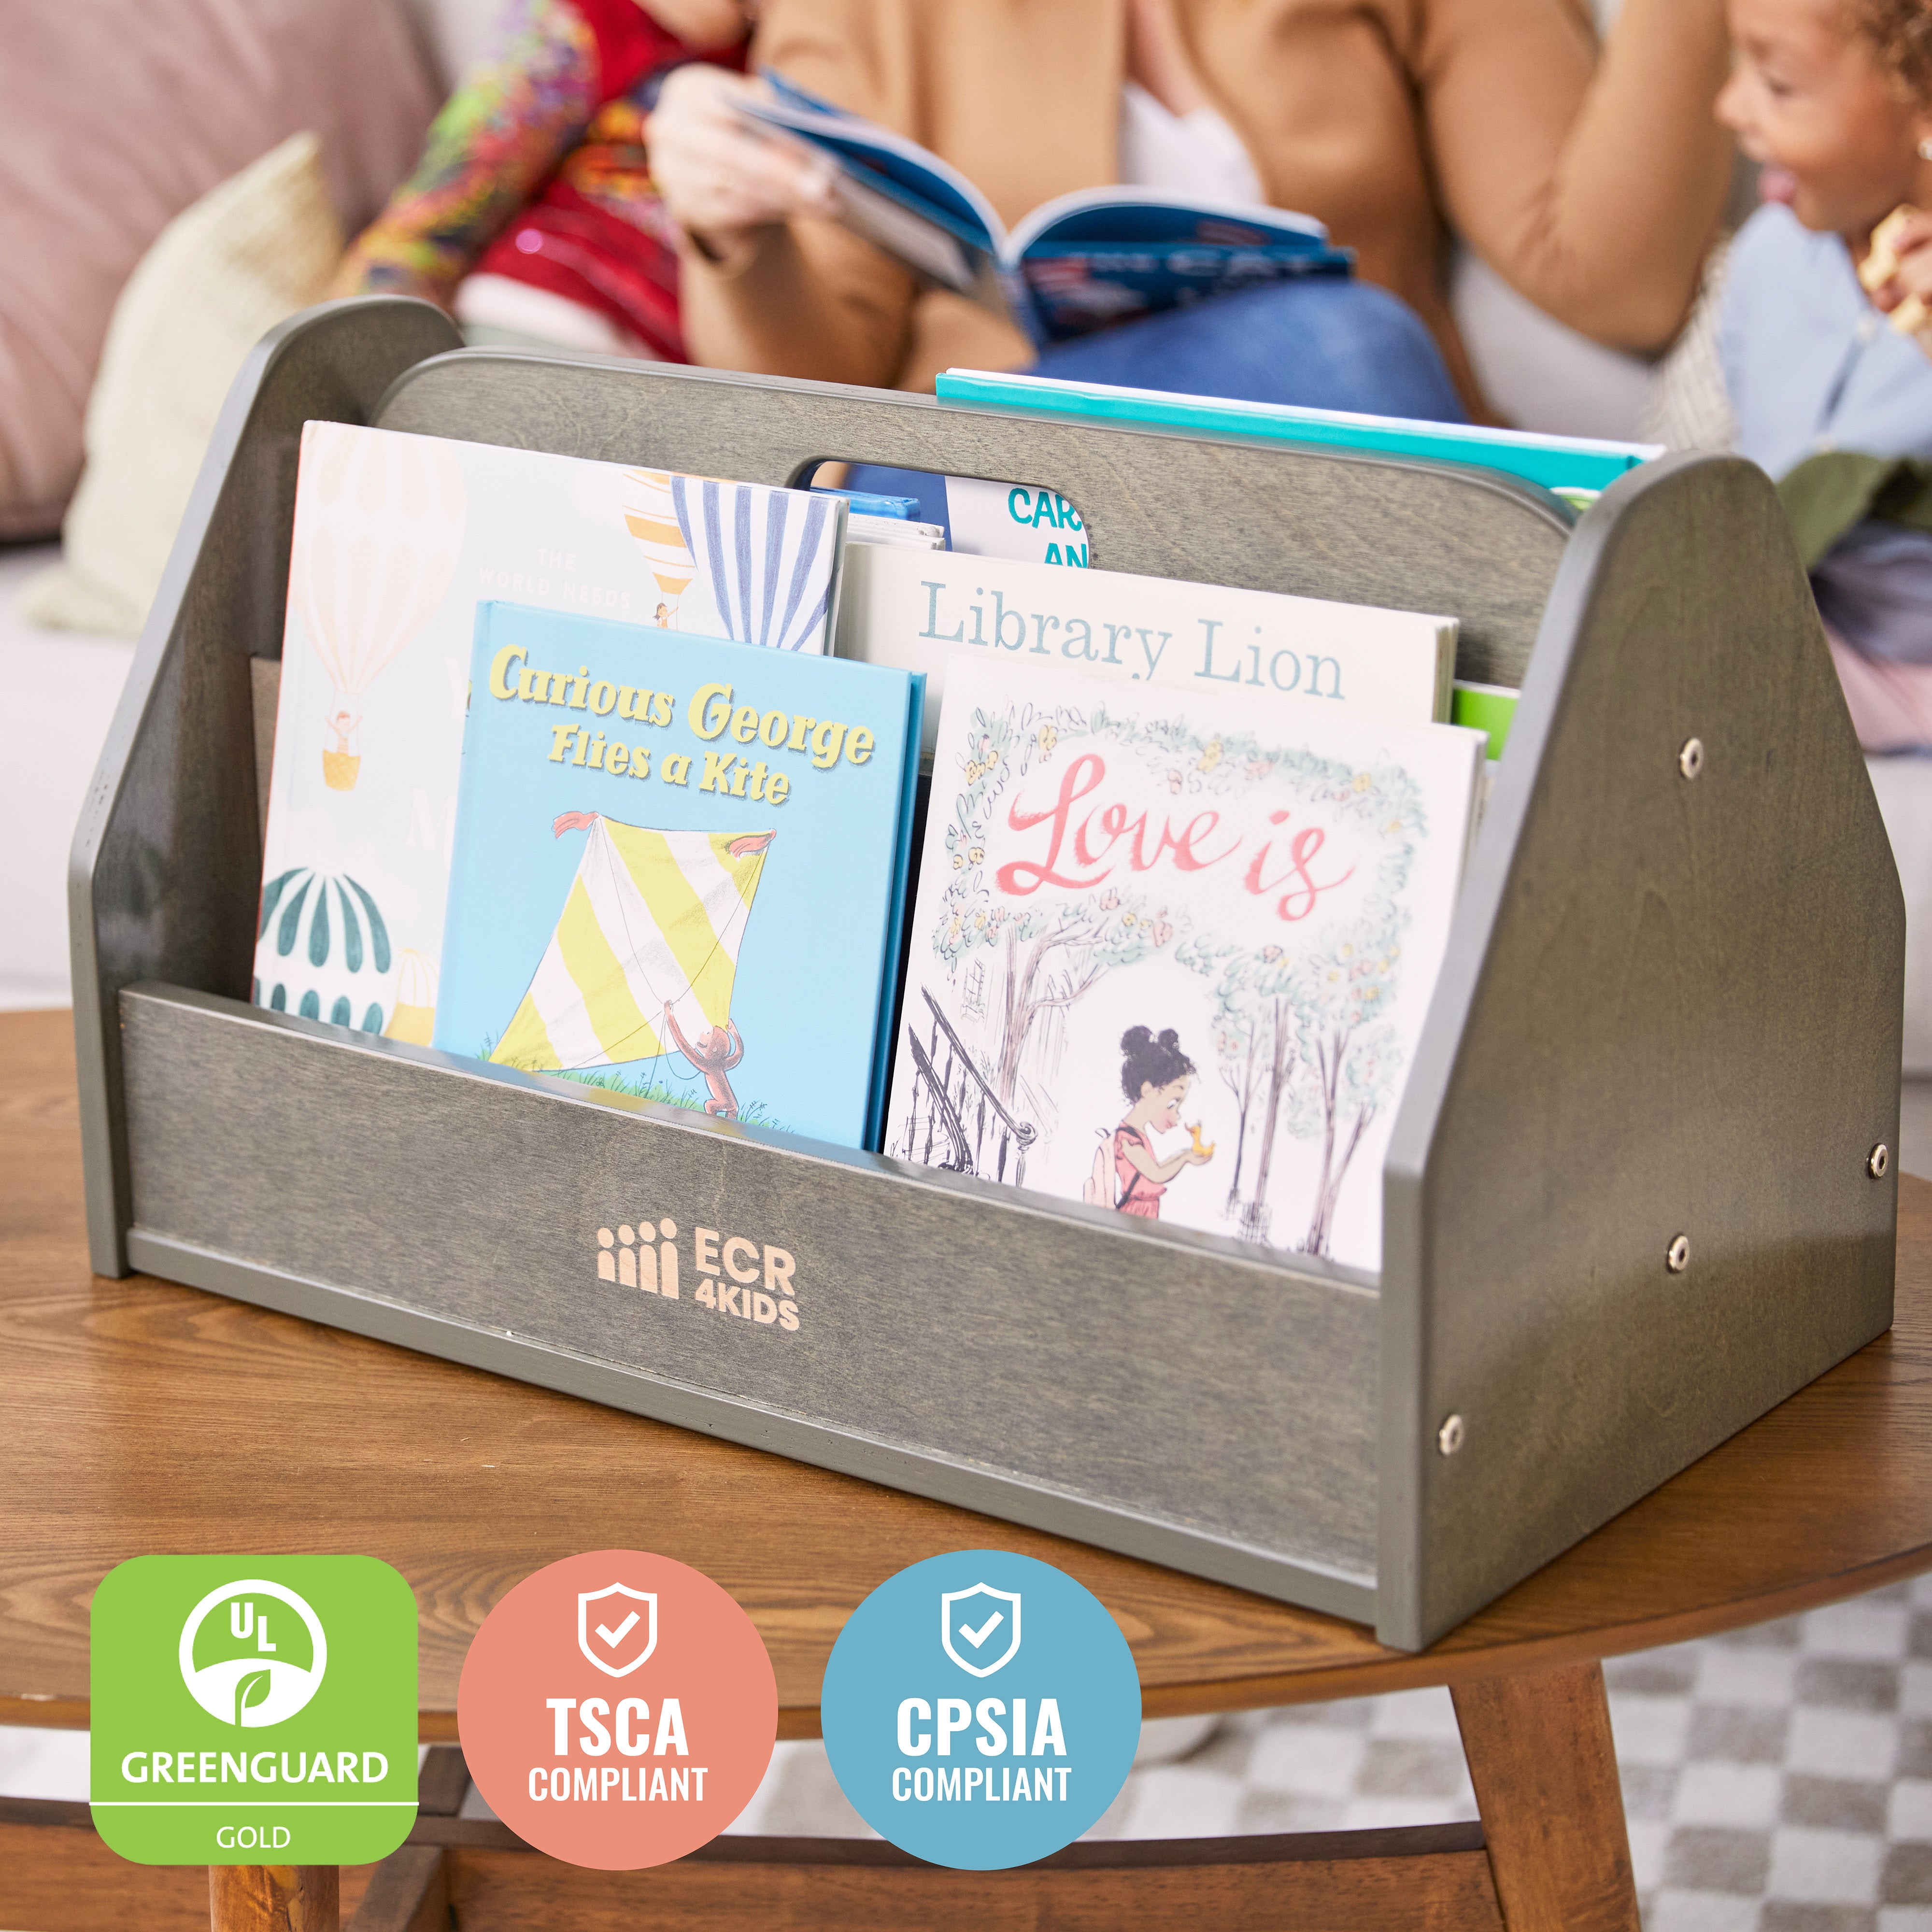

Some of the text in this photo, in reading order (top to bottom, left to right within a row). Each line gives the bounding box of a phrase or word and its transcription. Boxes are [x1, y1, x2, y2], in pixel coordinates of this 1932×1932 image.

[1008, 488, 1082, 531] CAR
[478, 567, 631, 610] WORLD NEEDS
[537, 548, 577, 572] THE
[918, 581, 1346, 700] Library Lion
[488, 643, 675, 727] Curious
[687, 682, 875, 769] George
[548, 724, 791, 805] Flies a Kite
[995, 753, 1354, 921] Love is
[695, 1227, 796, 1295] ECR
[695, 1279, 800, 1331] 4KIDS
